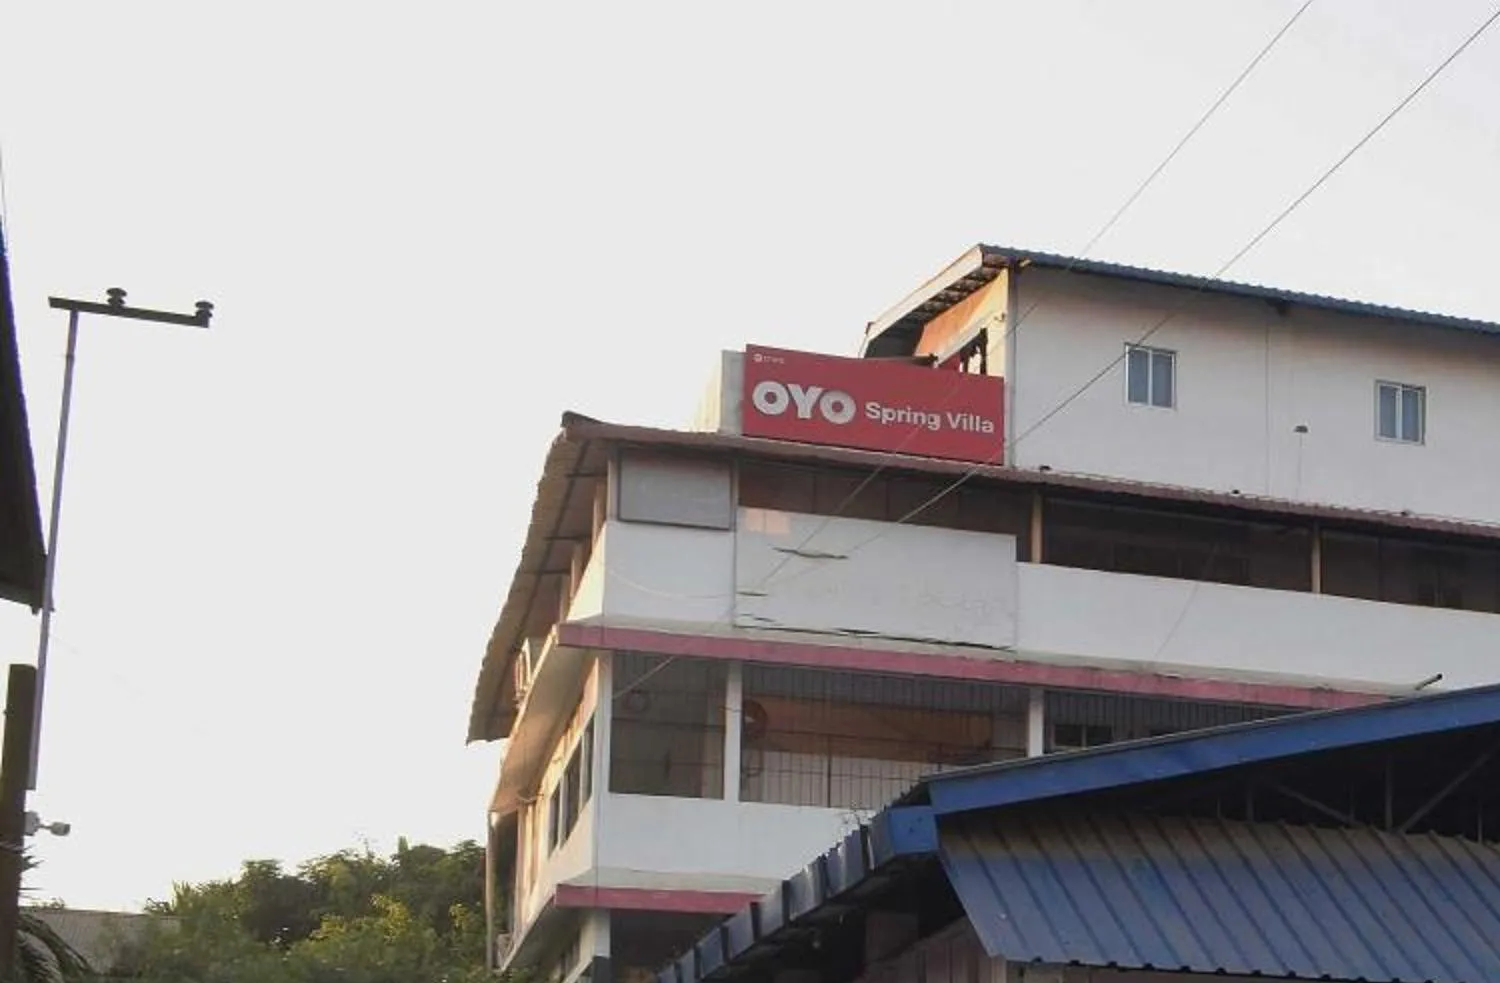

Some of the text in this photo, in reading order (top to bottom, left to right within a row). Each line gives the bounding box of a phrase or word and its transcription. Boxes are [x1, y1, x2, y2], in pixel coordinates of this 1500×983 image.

[752, 380, 995, 435] OYO Spring Villa
